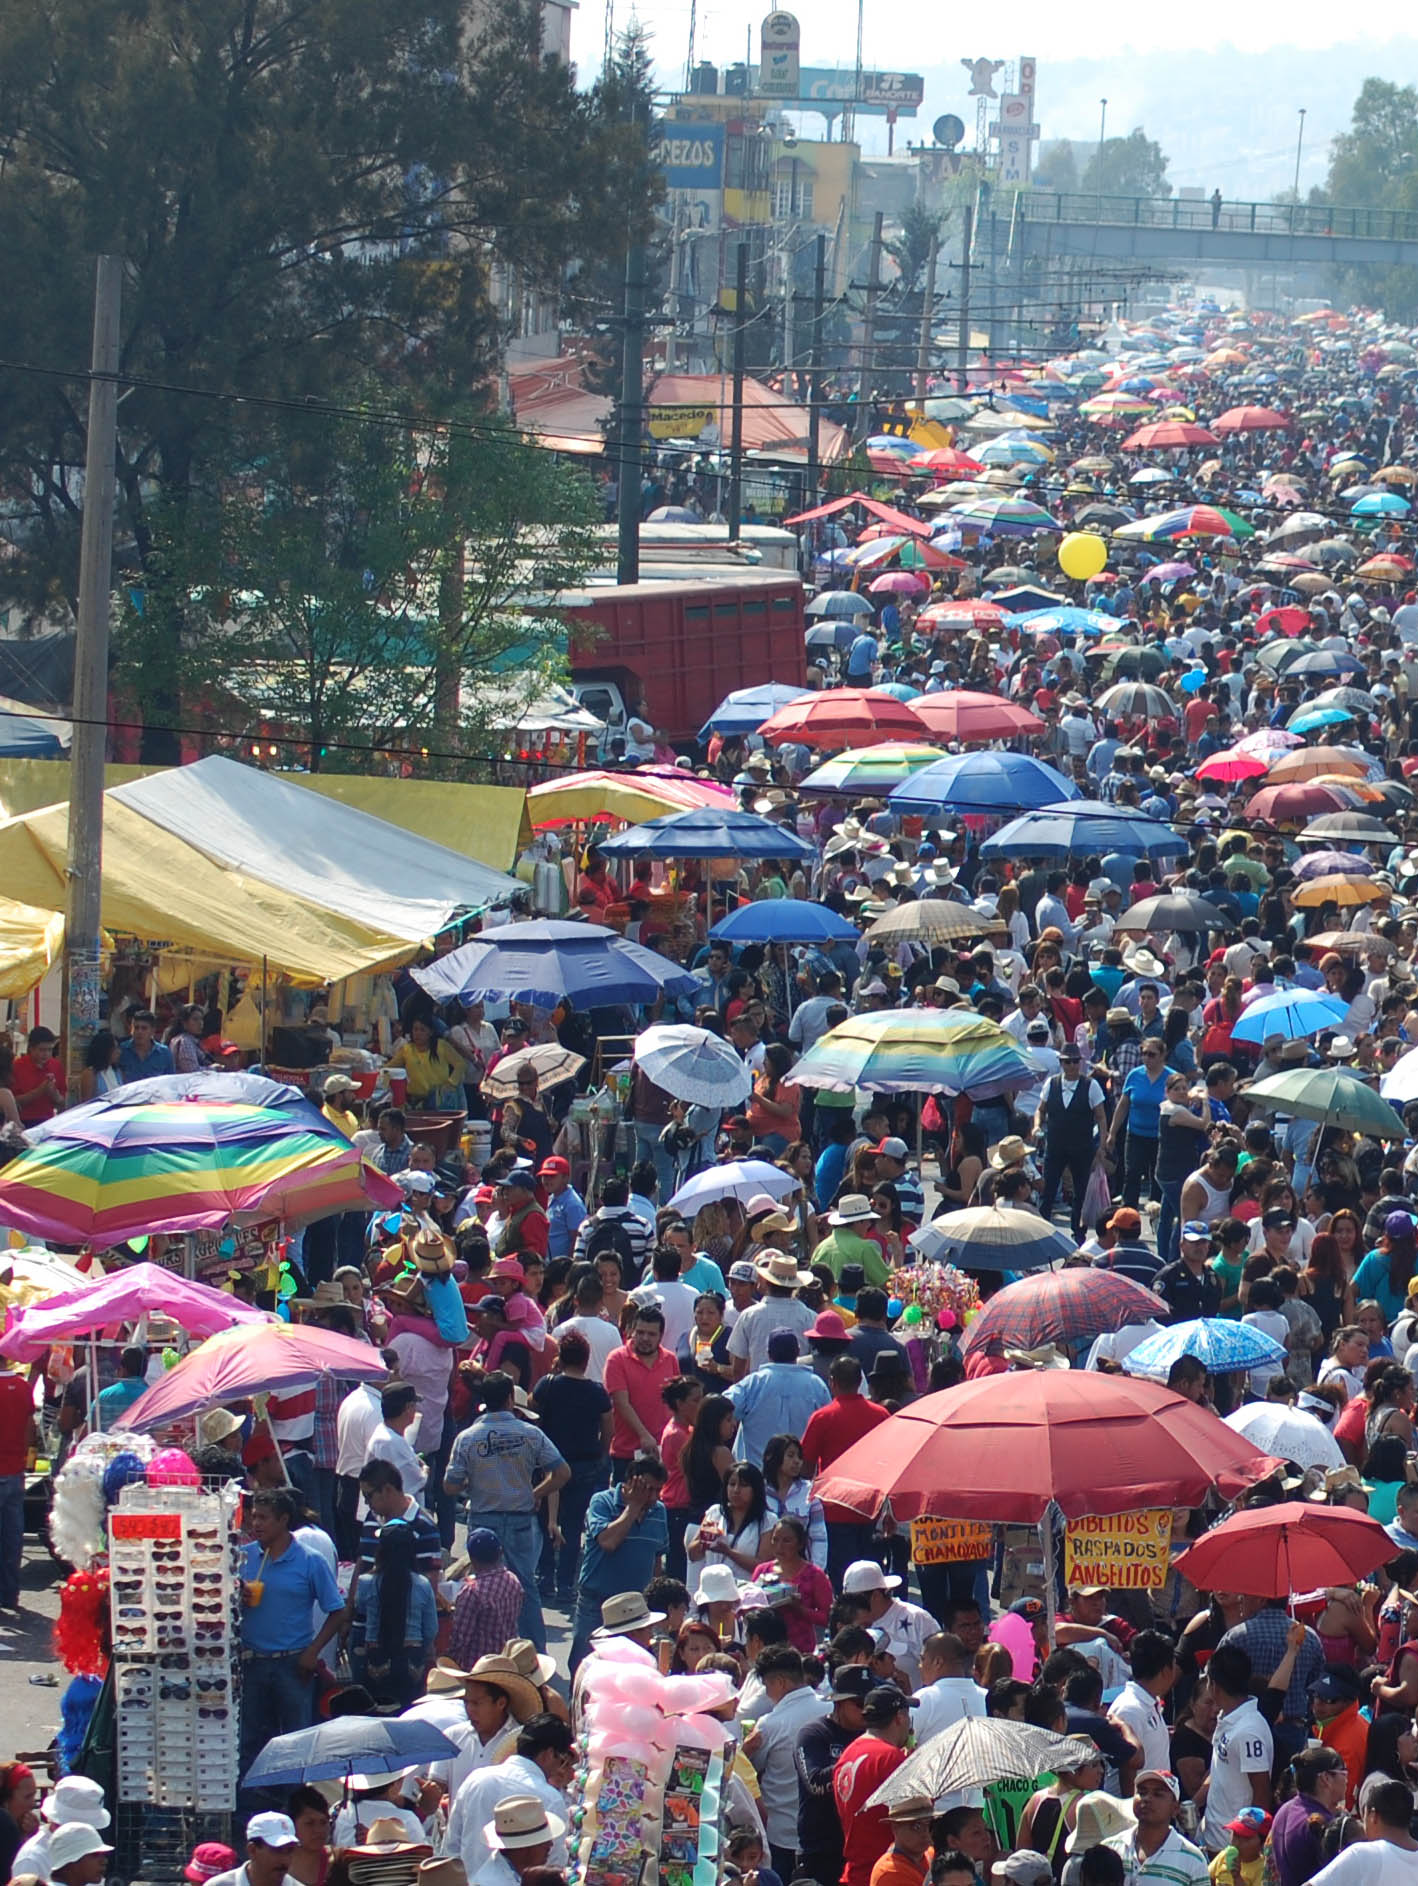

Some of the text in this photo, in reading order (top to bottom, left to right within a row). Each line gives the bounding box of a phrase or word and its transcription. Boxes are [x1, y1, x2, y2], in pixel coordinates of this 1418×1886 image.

[651, 409, 705, 422] Macedo
[1245, 1740, 1263, 1758] 18
[996, 1779, 1029, 1792] CHACO
